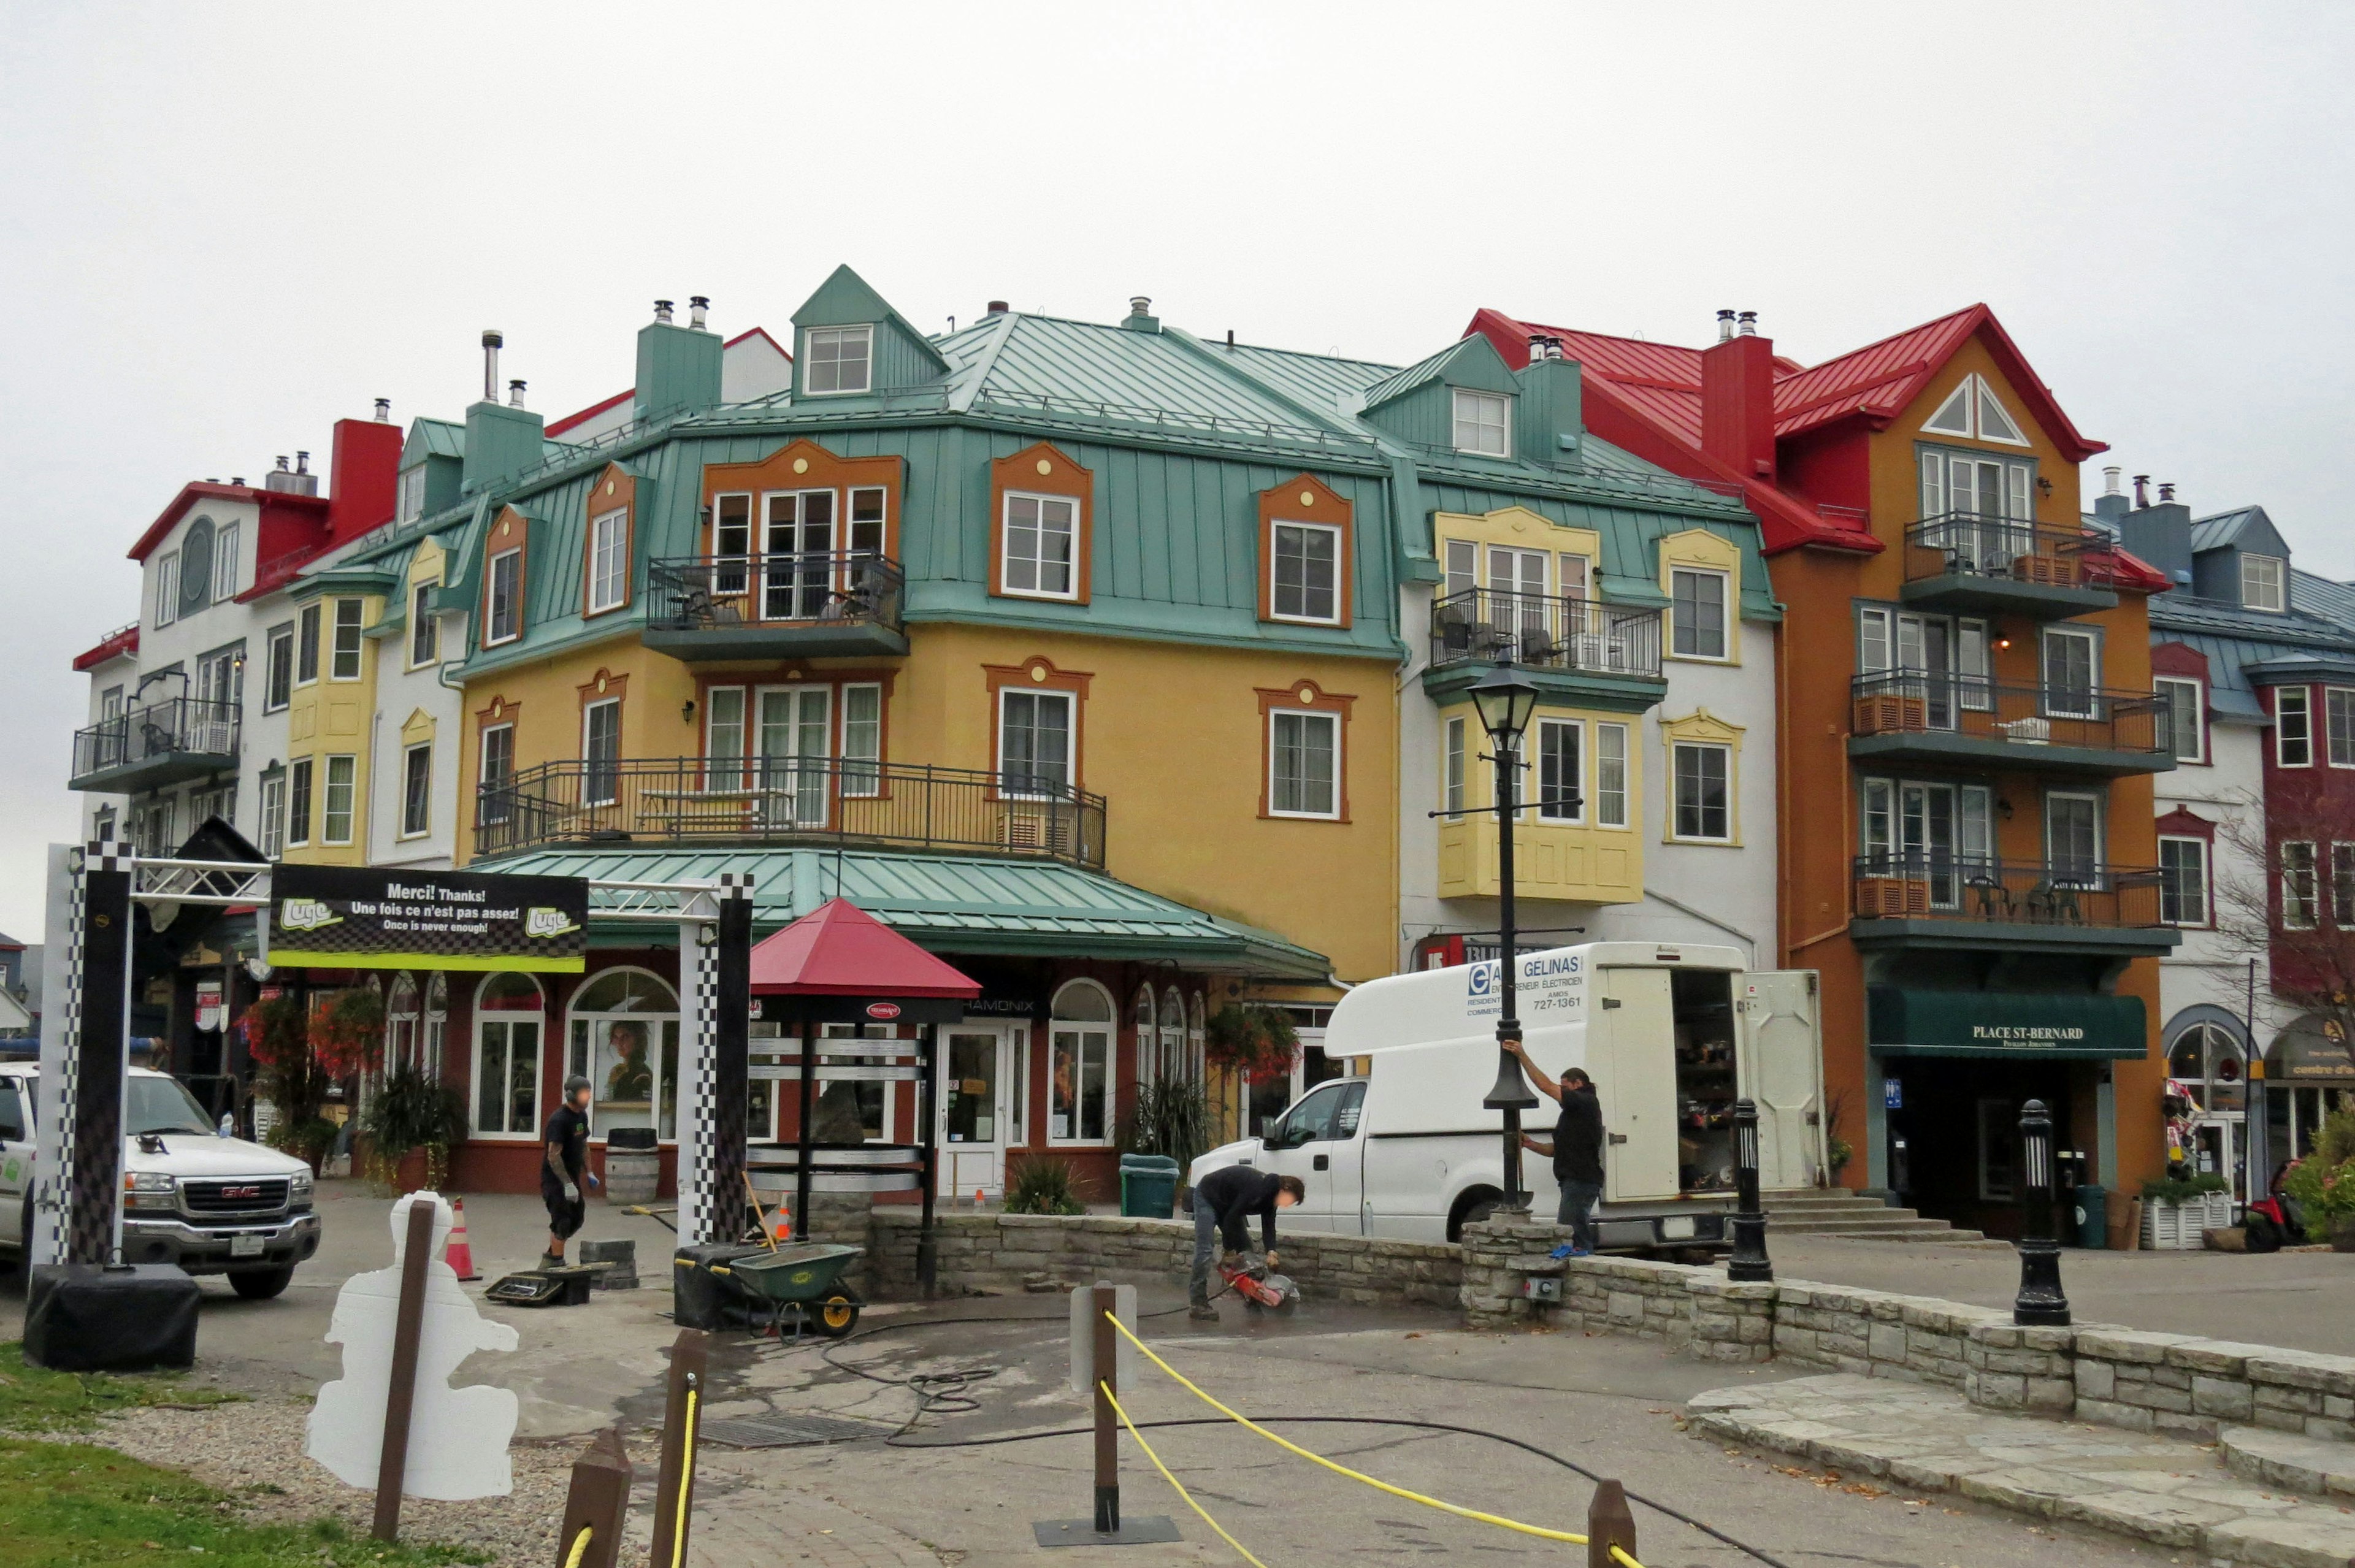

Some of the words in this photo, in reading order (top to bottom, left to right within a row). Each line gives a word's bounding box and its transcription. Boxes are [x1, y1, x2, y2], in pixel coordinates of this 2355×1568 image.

[387, 883, 435, 900] Merci!
[438, 889, 486, 902] Thanks!
[283, 899, 332, 928] Luge
[351, 901, 376, 915] Une
[380, 903, 402, 916] fois
[405, 906, 420, 916] ce
[424, 905, 454, 917] n'est
[457, 908, 478, 920] pas
[482, 908, 519, 919] assez!
[384, 919, 408, 930] Once
[411, 920, 419, 930] is
[422, 923, 448, 931] never
[451, 922, 488, 934] enough!
[529, 909, 571, 935] Luge
[1524, 957, 1579, 977] GÉLINAS
[1492, 981, 1539, 993] ENTRENEUR
[1542, 976, 1582, 989] ÉLECTRICIEN
[962, 1000, 1034, 1011] HAMONIX
[1534, 997, 1580, 1010] 727-1361
[1467, 1008, 1502, 1016] COMMERC
[1973, 1025, 2011, 1038] PLACE
[2013, 1027, 2083, 1039] ST-BERNARD
[222, 1185, 260, 1198] GMC
